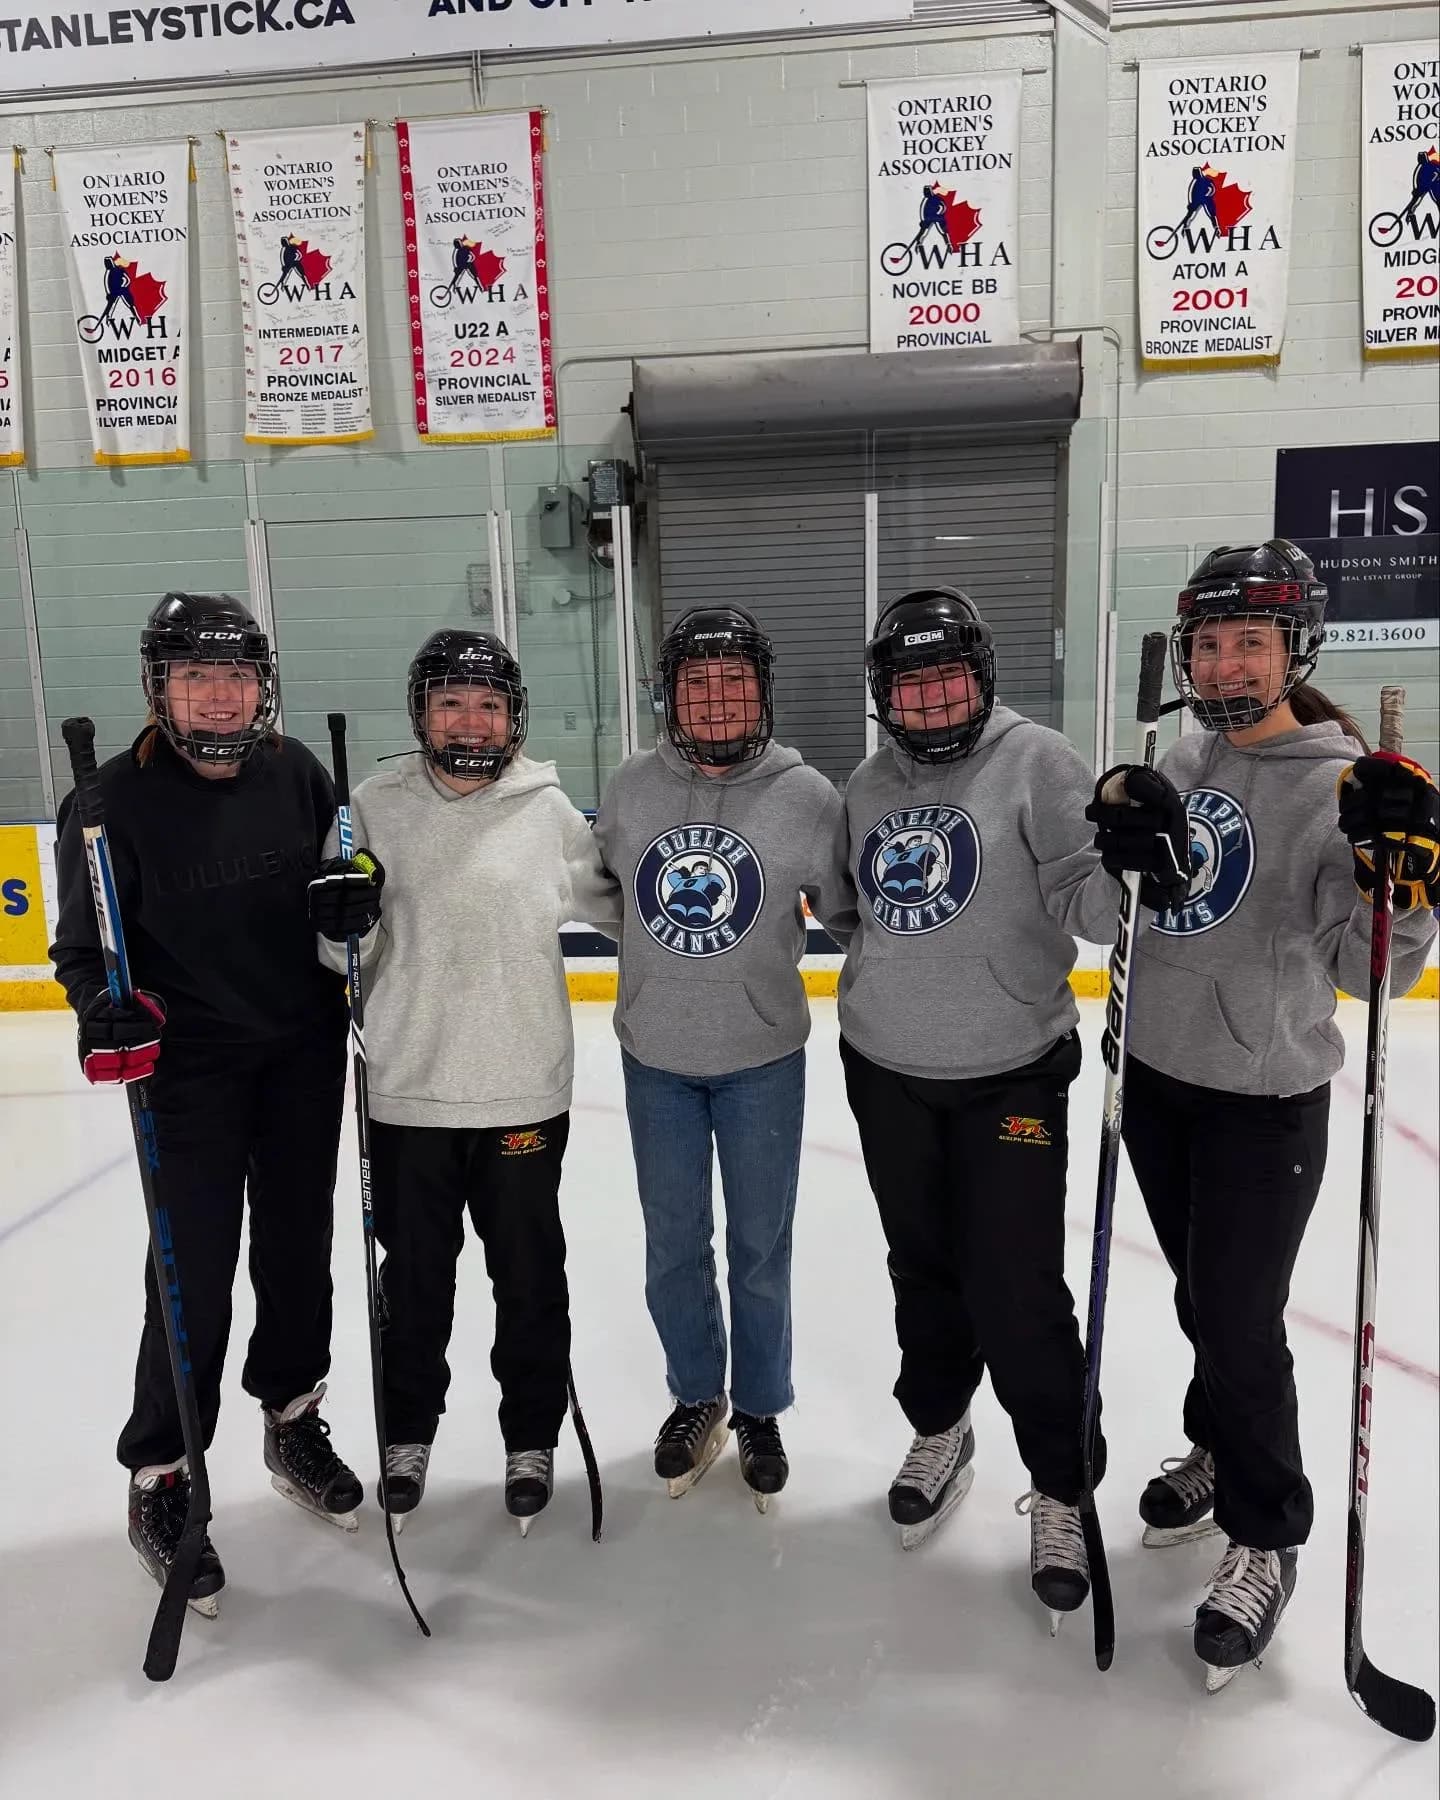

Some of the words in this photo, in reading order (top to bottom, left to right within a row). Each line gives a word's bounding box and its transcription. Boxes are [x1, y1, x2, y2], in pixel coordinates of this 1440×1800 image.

[0, 0, 356, 53] TANLEYSTICK.CA
[1169, 74, 1267, 96] ONTARIO
[898, 94, 992, 117] ONTARIO
[1168, 94, 1268, 116] WOMEN'S
[898, 114, 993, 137] WOMEN'S
[1172, 115, 1261, 136] HOCKEY
[902, 135, 988, 156] HOCKEY
[1146, 134, 1287, 158] ASSOCIATION
[263, 161, 333, 177] ONTARIO
[437, 162, 508, 179] ONTARIO
[878, 152, 1014, 177] ASSOCIATION
[82, 170, 166, 190] ONTARIO
[263, 176, 335, 192] WOMEN'S
[437, 176, 510, 194] WOMEN'S
[83, 190, 169, 209] WOMEN'S
[269, 191, 333, 207] HOCKEY
[442, 192, 505, 208] HOCKEY
[90, 209, 165, 228] HOCKEY
[251, 205, 353, 223] ASSOCIATION
[424, 206, 526, 225] ASSOCIATION
[70, 226, 188, 249] ASSOCIATION
[1383, 248, 1439, 268] MIDG
[1172, 261, 1226, 281] ATOM
[1235, 260, 1249, 277] A
[892, 279, 963, 299] NOVICE
[972, 278, 998, 295] BB
[1172, 287, 1249, 311] 2001
[908, 302, 981, 326] 2000
[258, 324, 349, 339] INTERMEDIATE
[351, 323, 360, 334] A
[454, 321, 490, 340] U22
[496, 320, 509, 337] A
[1160, 316, 1257, 334] PROVINCIAL
[897, 330, 992, 349] PROVINCIAL
[1145, 339, 1199, 355] BRONZE
[1204, 335, 1273, 353] MEDALIST
[1366, 327, 1418, 344] SILVER
[97, 346, 167, 364] MIDGET
[279, 344, 344, 366] 2017
[450, 346, 517, 368] 2024
[108, 366, 177, 389] 2016
[267, 371, 358, 388] PROVINCIAL
[438, 372, 532, 391] PROVINCIAL
[96, 395, 178, 412] PROVINCIA
[260, 391, 309, 402] BRONZE
[311, 387, 364, 401] MEDALIST
[435, 394, 475, 407] SILVER
[477, 391, 537, 405] MEDALIST
[96, 416, 133, 428] ILVER
[1320, 555, 1382, 569] HUDSON
[1389, 555, 1438, 568] SMITH
[1341, 574, 1361, 582] REAL
[1363, 573, 1391, 581] ESTATE
[1395, 572, 1423, 580] GROUP
[1196, 587, 1241, 600] BAUER
[199, 631, 243, 640] CCM
[907, 630, 943, 644] CCM
[1323, 625, 1427, 643] 19.821.3600
[458, 653, 494, 662] CCM
[201, 746, 245, 755] CCM
[454, 758, 495, 768] CCM
[877, 810, 962, 840] GUELPH
[1181, 793, 1242, 838] ELPH
[656, 829, 750, 865] GUELPH
[873, 890, 959, 929] GIANTS
[649, 914, 737, 953] GIANTS
[361, 1158, 372, 1211] BAUER
